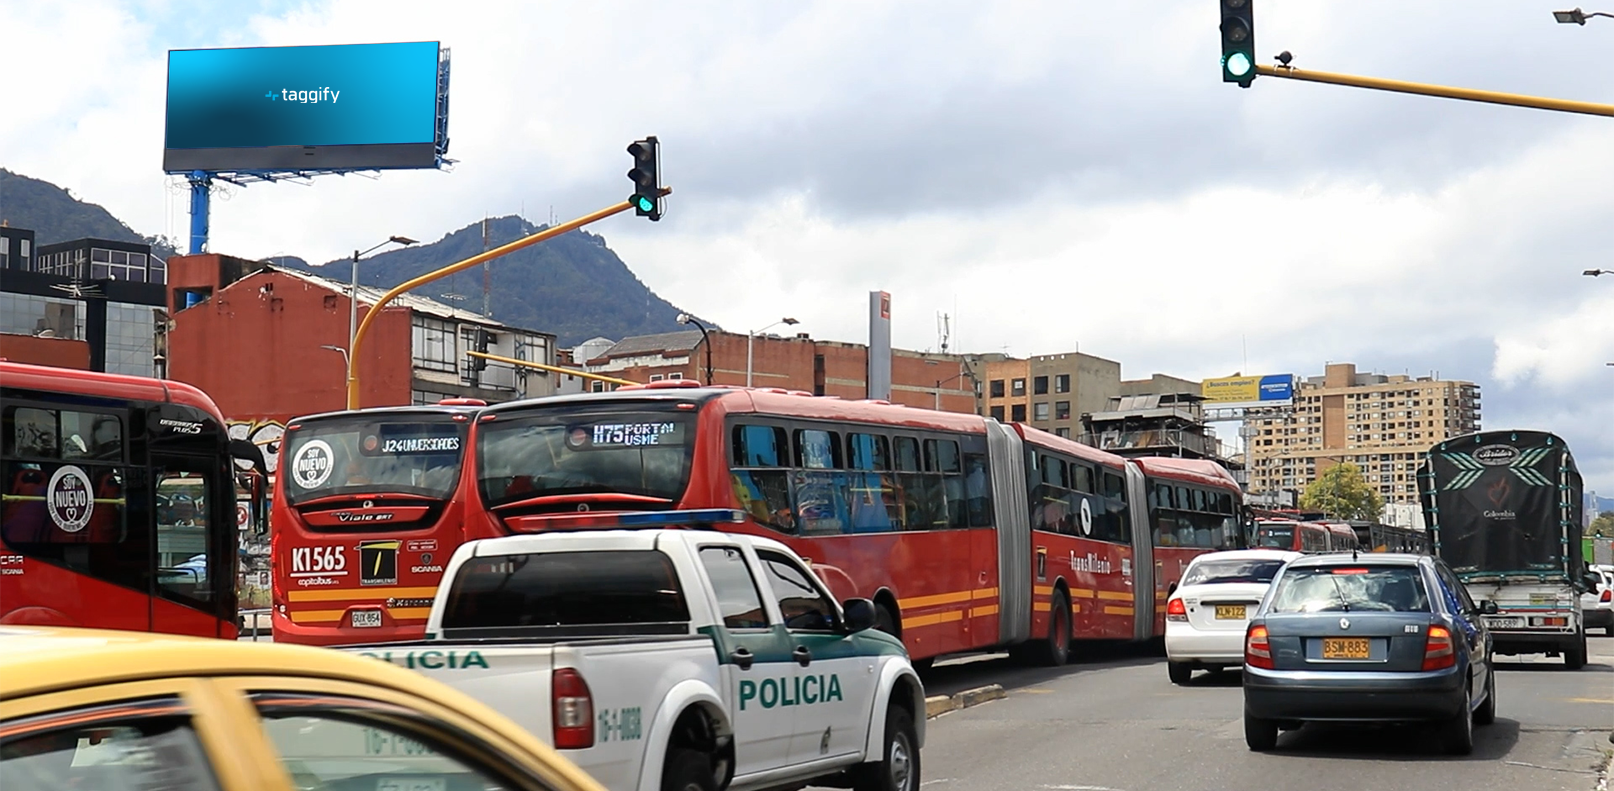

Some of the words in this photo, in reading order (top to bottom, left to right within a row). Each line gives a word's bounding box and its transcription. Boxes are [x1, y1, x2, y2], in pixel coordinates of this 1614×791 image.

[281, 86, 340, 104] taggify
[593, 424, 624, 444] H75
[624, 434, 659, 446] USME
[382, 439, 403, 453] J24
[307, 448, 320, 459] SOY
[299, 457, 327, 472] NUEVO
[63, 477, 76, 490] SOY
[55, 490, 87, 508] NUEVO
[292, 546, 346, 571] K1565
[411, 565, 443, 573] SCANIA
[353, 613, 380, 623] GUX-854
[1325, 641, 1368, 654] BSM-883
[739, 674, 842, 711] POLICIA
